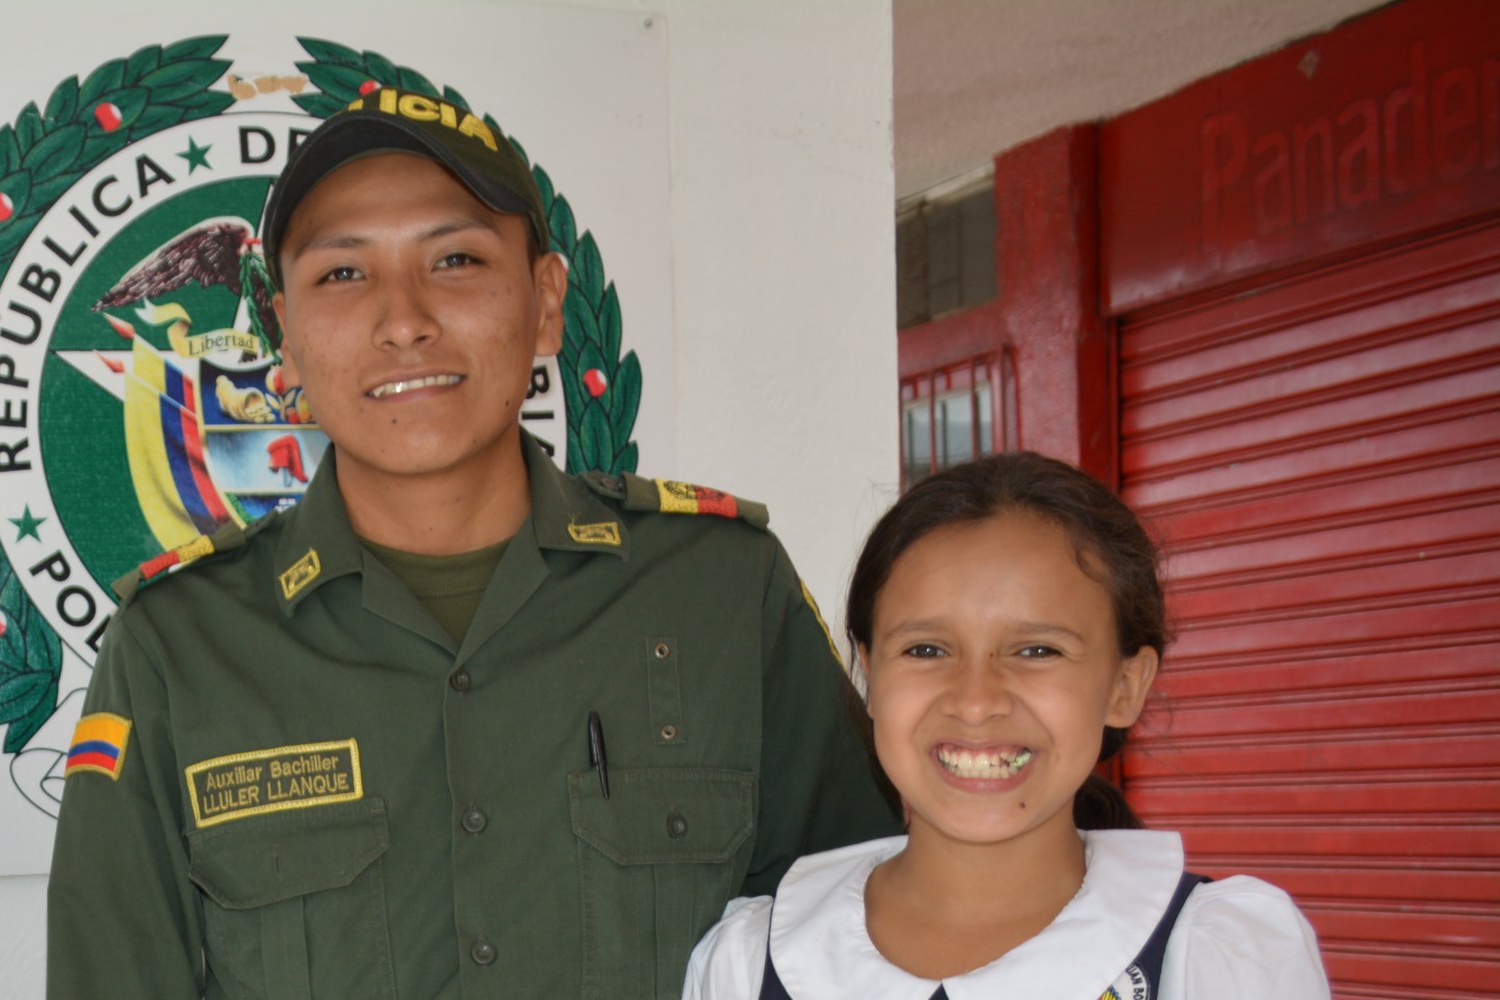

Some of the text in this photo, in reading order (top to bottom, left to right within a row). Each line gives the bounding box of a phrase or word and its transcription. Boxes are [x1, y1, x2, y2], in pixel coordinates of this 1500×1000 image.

[347, 88, 498, 151] ICIA
[188, 334, 254, 356] Libertad
[206, 754, 339, 790] Auxiliar Bachiller
[203, 773, 349, 814] LLULER LLANQUE
